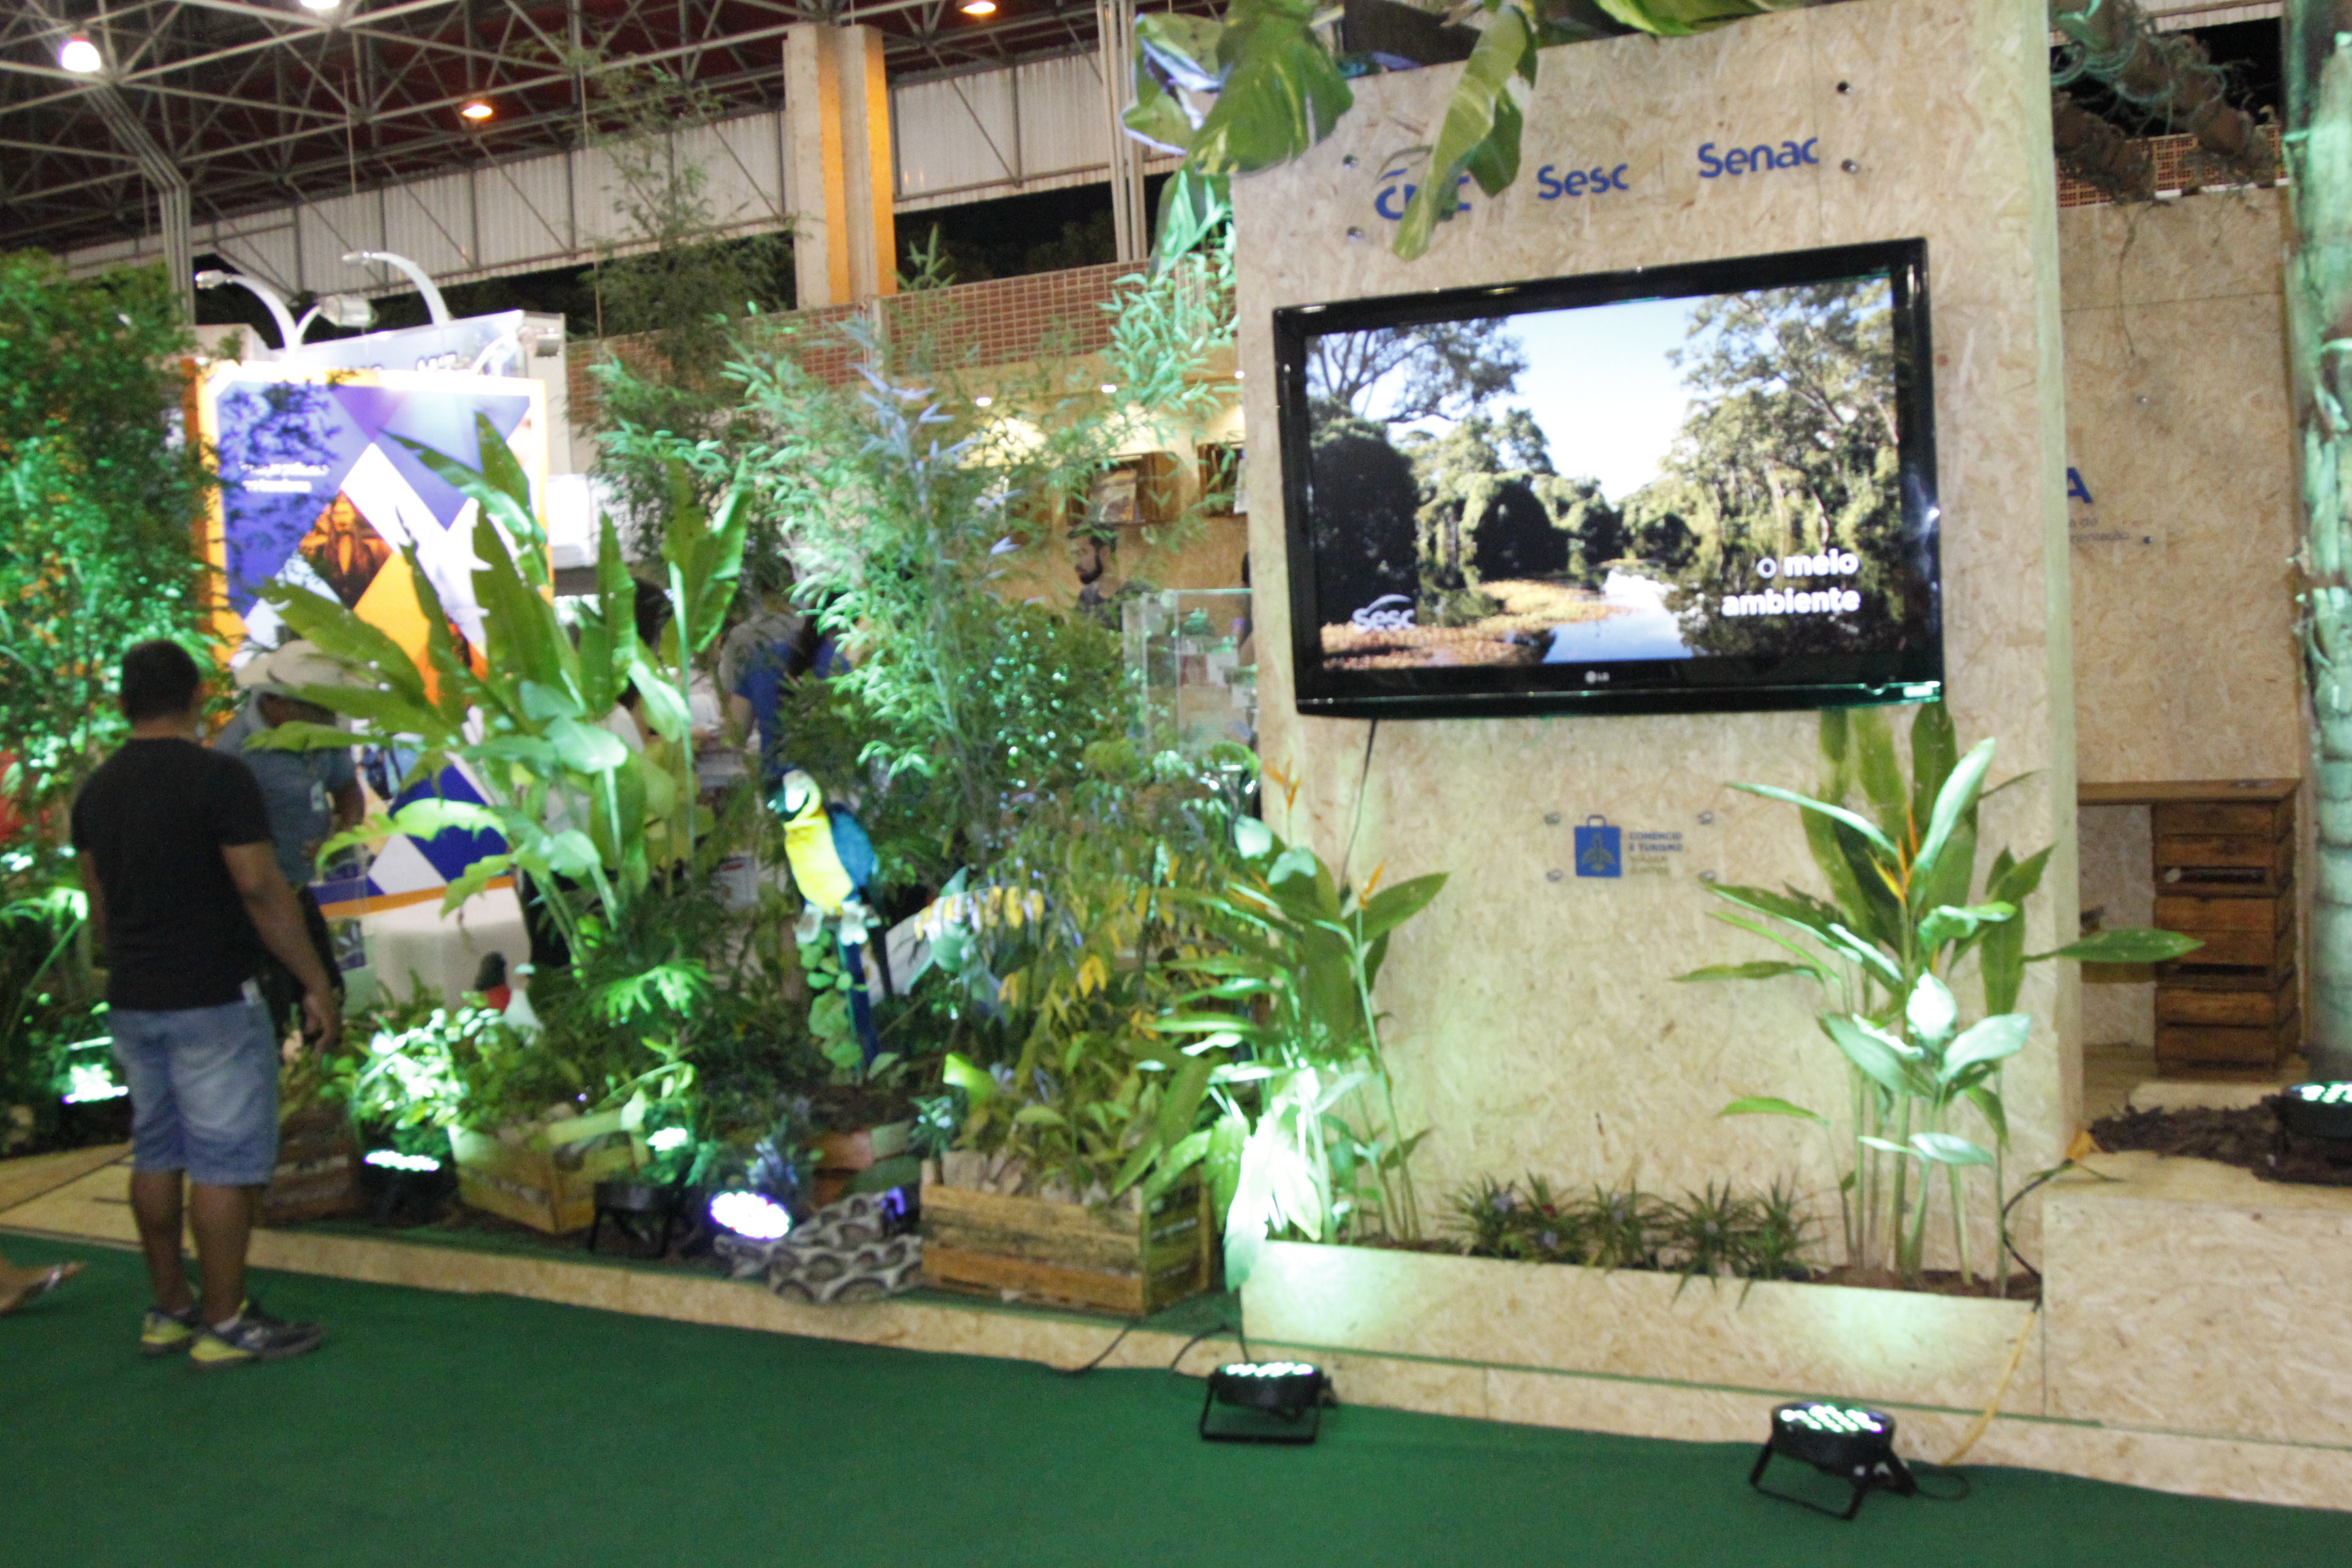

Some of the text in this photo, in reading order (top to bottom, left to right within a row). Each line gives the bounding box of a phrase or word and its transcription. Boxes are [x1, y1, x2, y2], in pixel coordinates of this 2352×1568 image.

[1697, 136, 1820, 178] Senac
[1536, 163, 1631, 200] Sesc
[1783, 547, 1861, 578] meio
[1720, 586, 1862, 617] ambiente
[1351, 607, 1417, 634] Sesc
